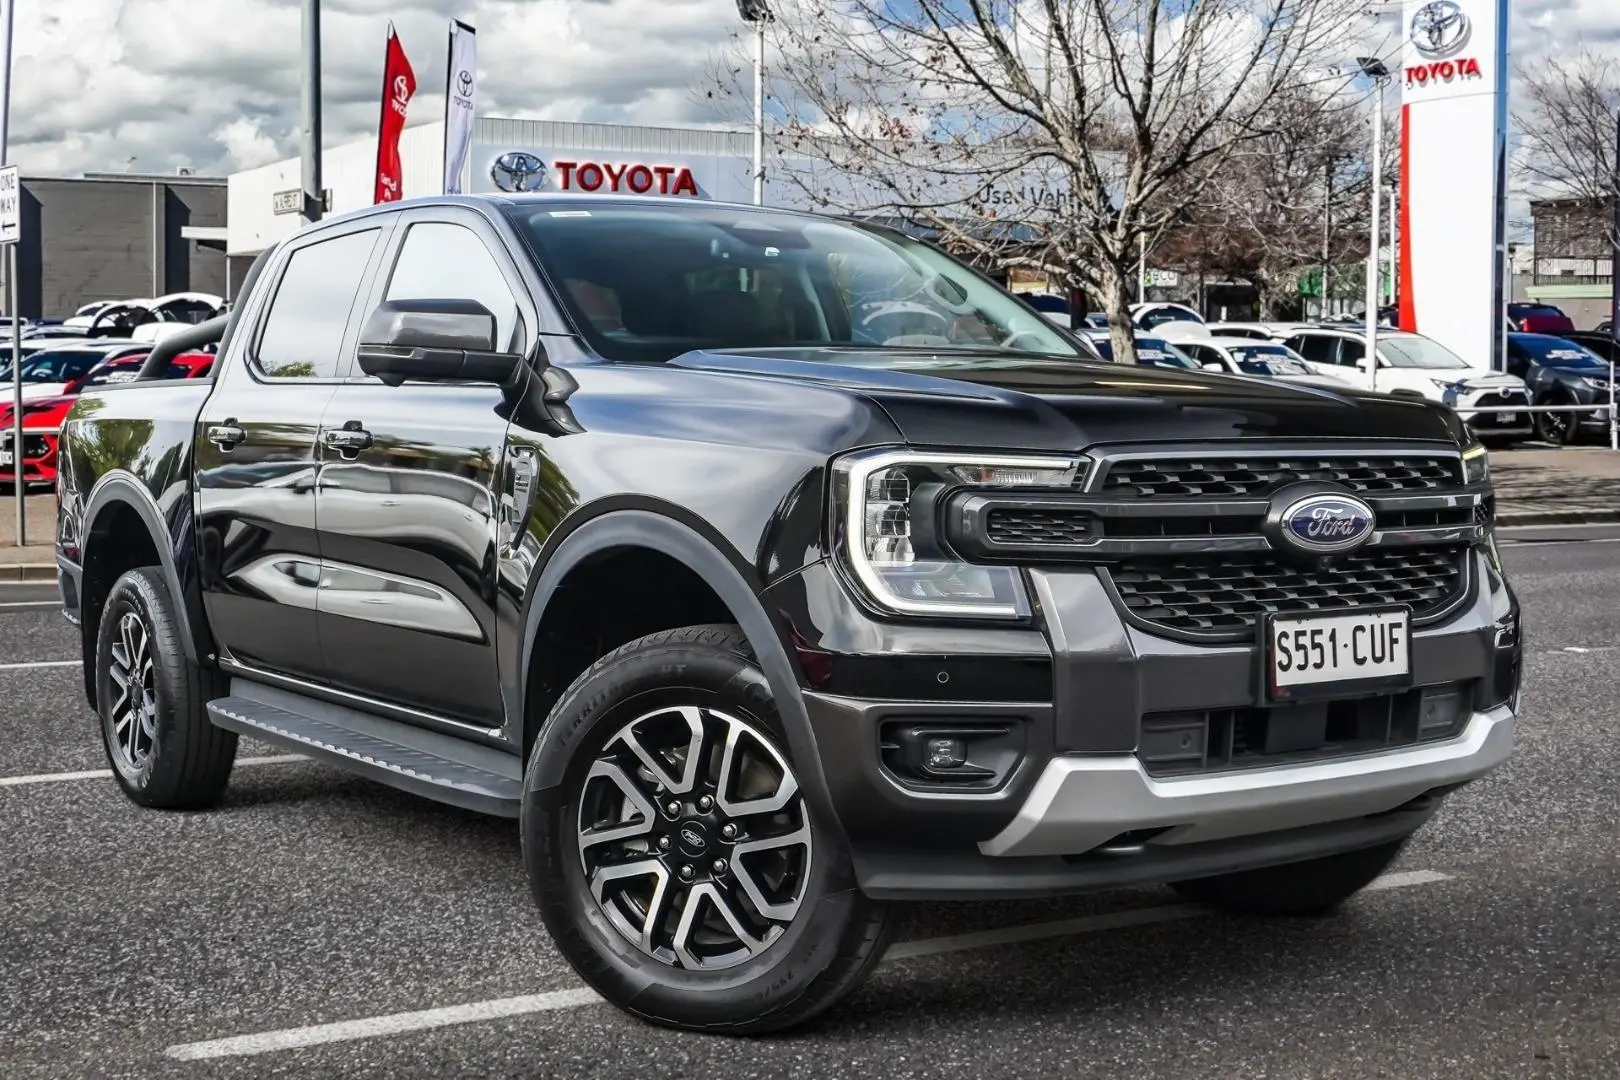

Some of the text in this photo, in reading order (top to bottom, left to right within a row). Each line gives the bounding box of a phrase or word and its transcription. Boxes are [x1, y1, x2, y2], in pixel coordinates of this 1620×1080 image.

[1404, 58, 1480, 84] TOYOTA
[1, 173, 15, 191] ONE
[555, 161, 698, 196] TOYOTA
[0, 195, 16, 213] WAY
[1307, 507, 1356, 537] Ford
